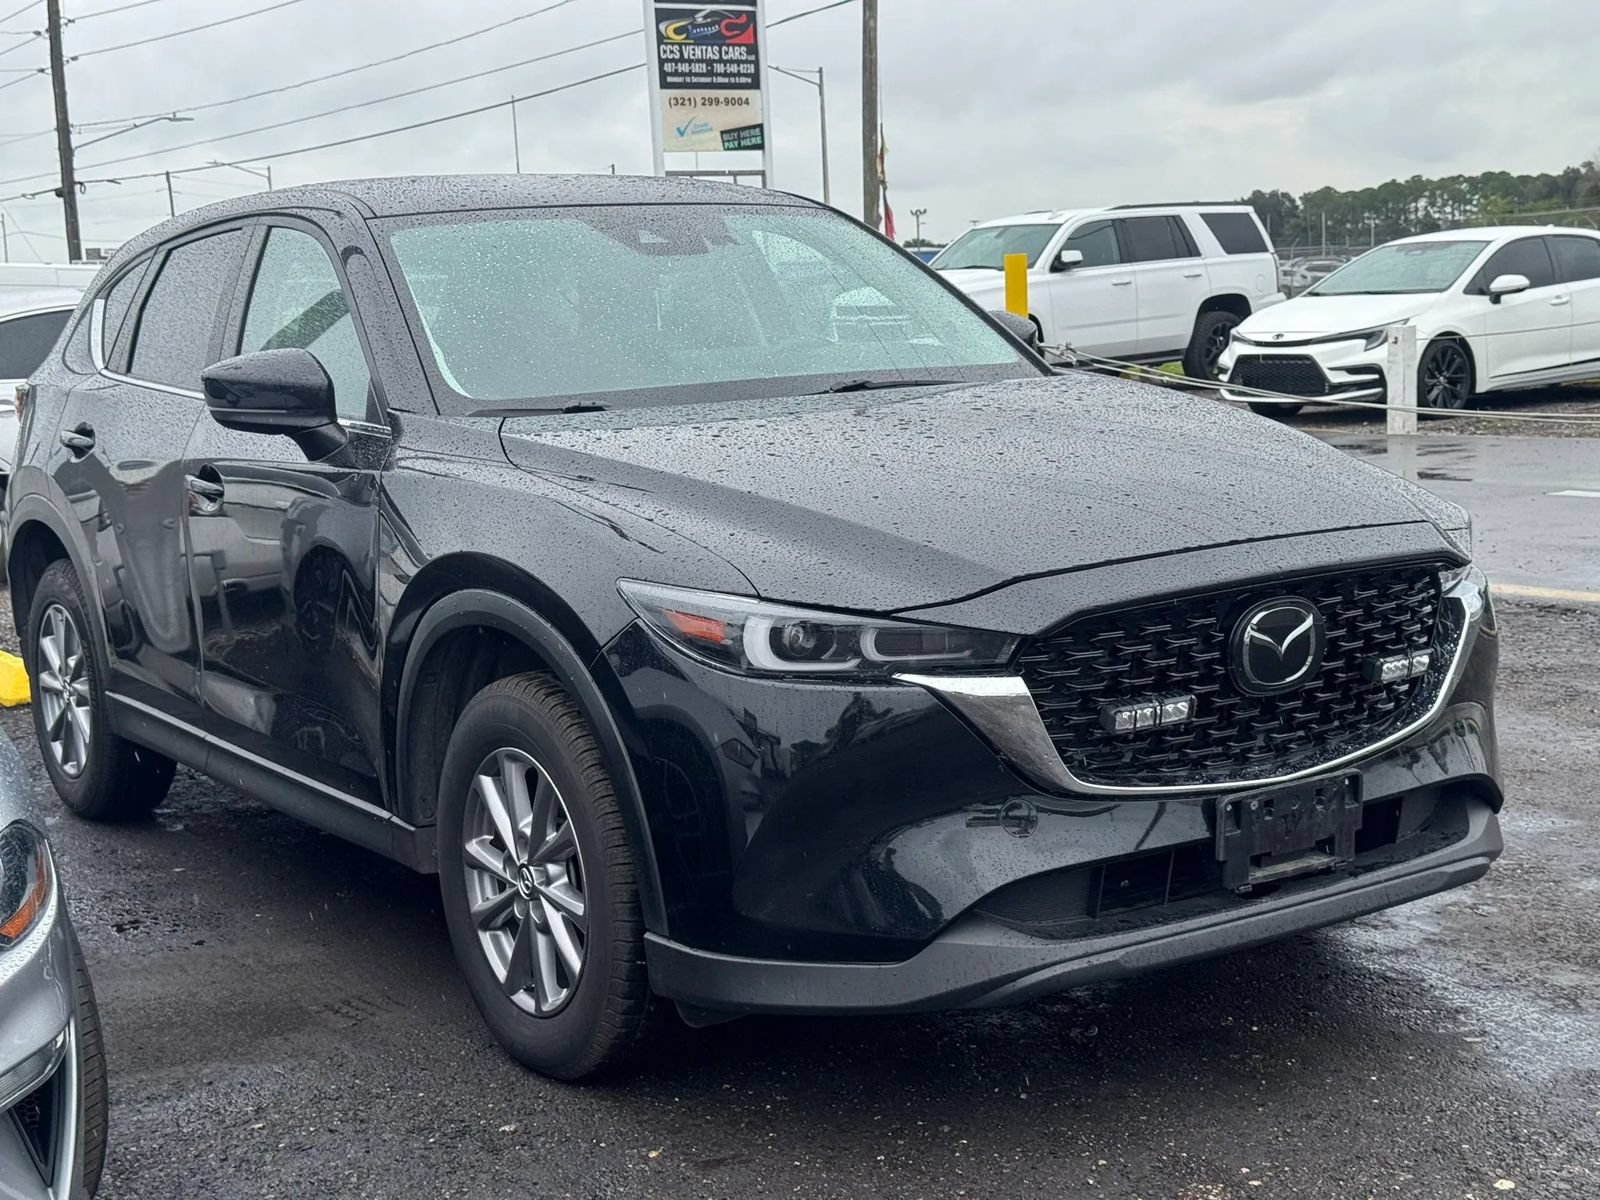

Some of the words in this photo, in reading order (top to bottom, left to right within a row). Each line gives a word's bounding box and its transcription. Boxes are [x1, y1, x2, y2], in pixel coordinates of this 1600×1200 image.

[660, 45, 680, 59] CCS
[682, 45, 719, 60] VENTAS
[722, 46, 747, 60] CARS
[668, 96, 697, 108] (321)
[701, 97, 750, 106] 299-9004
[722, 131, 738, 141] BUY
[739, 128, 761, 138] HERE
[724, 140, 739, 149] PAY
[740, 136, 762, 147] HERE
